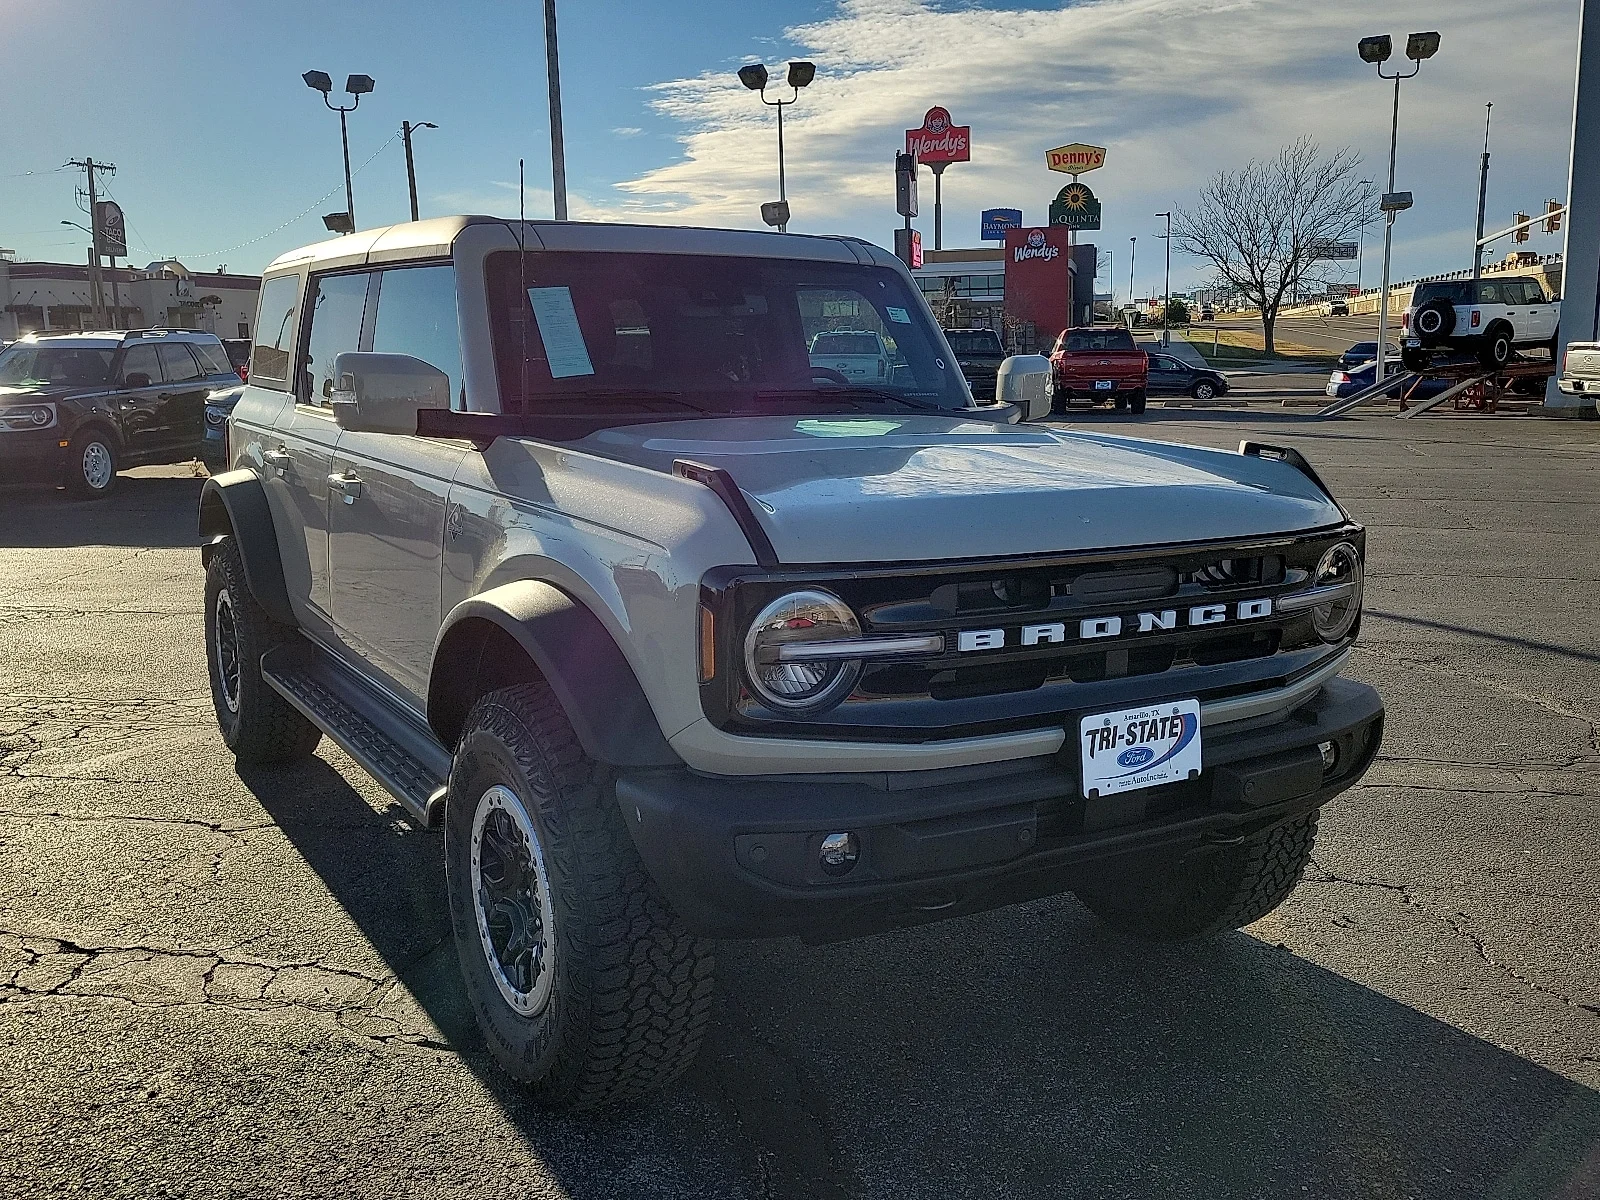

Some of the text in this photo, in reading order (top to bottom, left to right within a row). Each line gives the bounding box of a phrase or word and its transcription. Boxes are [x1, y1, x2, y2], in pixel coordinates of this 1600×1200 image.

[910, 131, 966, 156] Wendy's
[1051, 150, 1101, 166] Denny's
[983, 222, 1020, 230] BAYMONT
[1058, 214, 1099, 226] QUINTA
[105, 226, 122, 237] TACO
[1014, 242, 1059, 262] Wendy's
[958, 598, 1272, 651] BRONCO
[1151, 709, 1160, 717] TX
[1085, 715, 1182, 759] TRI-STATE
[1124, 750, 1147, 764] Ford
